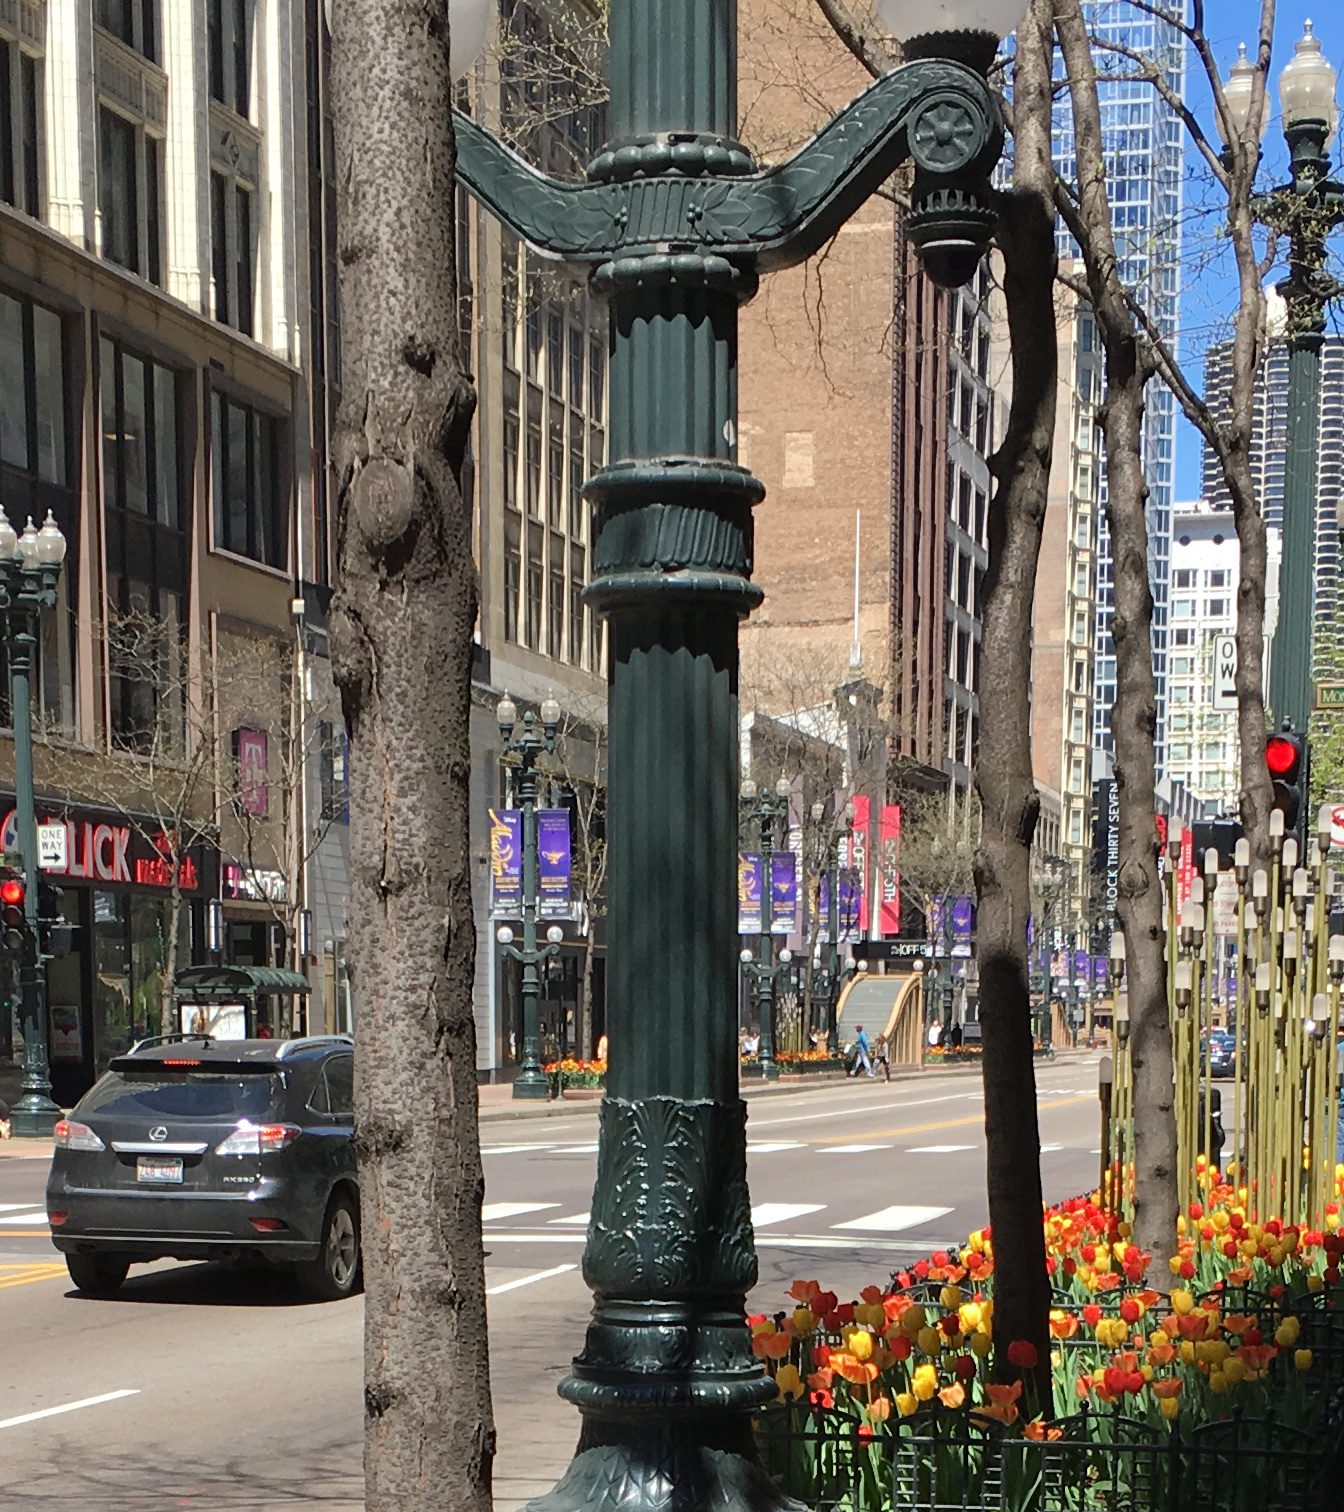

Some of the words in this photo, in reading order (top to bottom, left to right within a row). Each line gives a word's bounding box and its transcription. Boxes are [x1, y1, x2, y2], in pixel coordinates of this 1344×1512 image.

[41, 829, 63, 840] ONE
[41, 841, 63, 851] WAY
[1107, 825, 1120, 867] THIRTY
[44, 816, 132, 882] LICK
